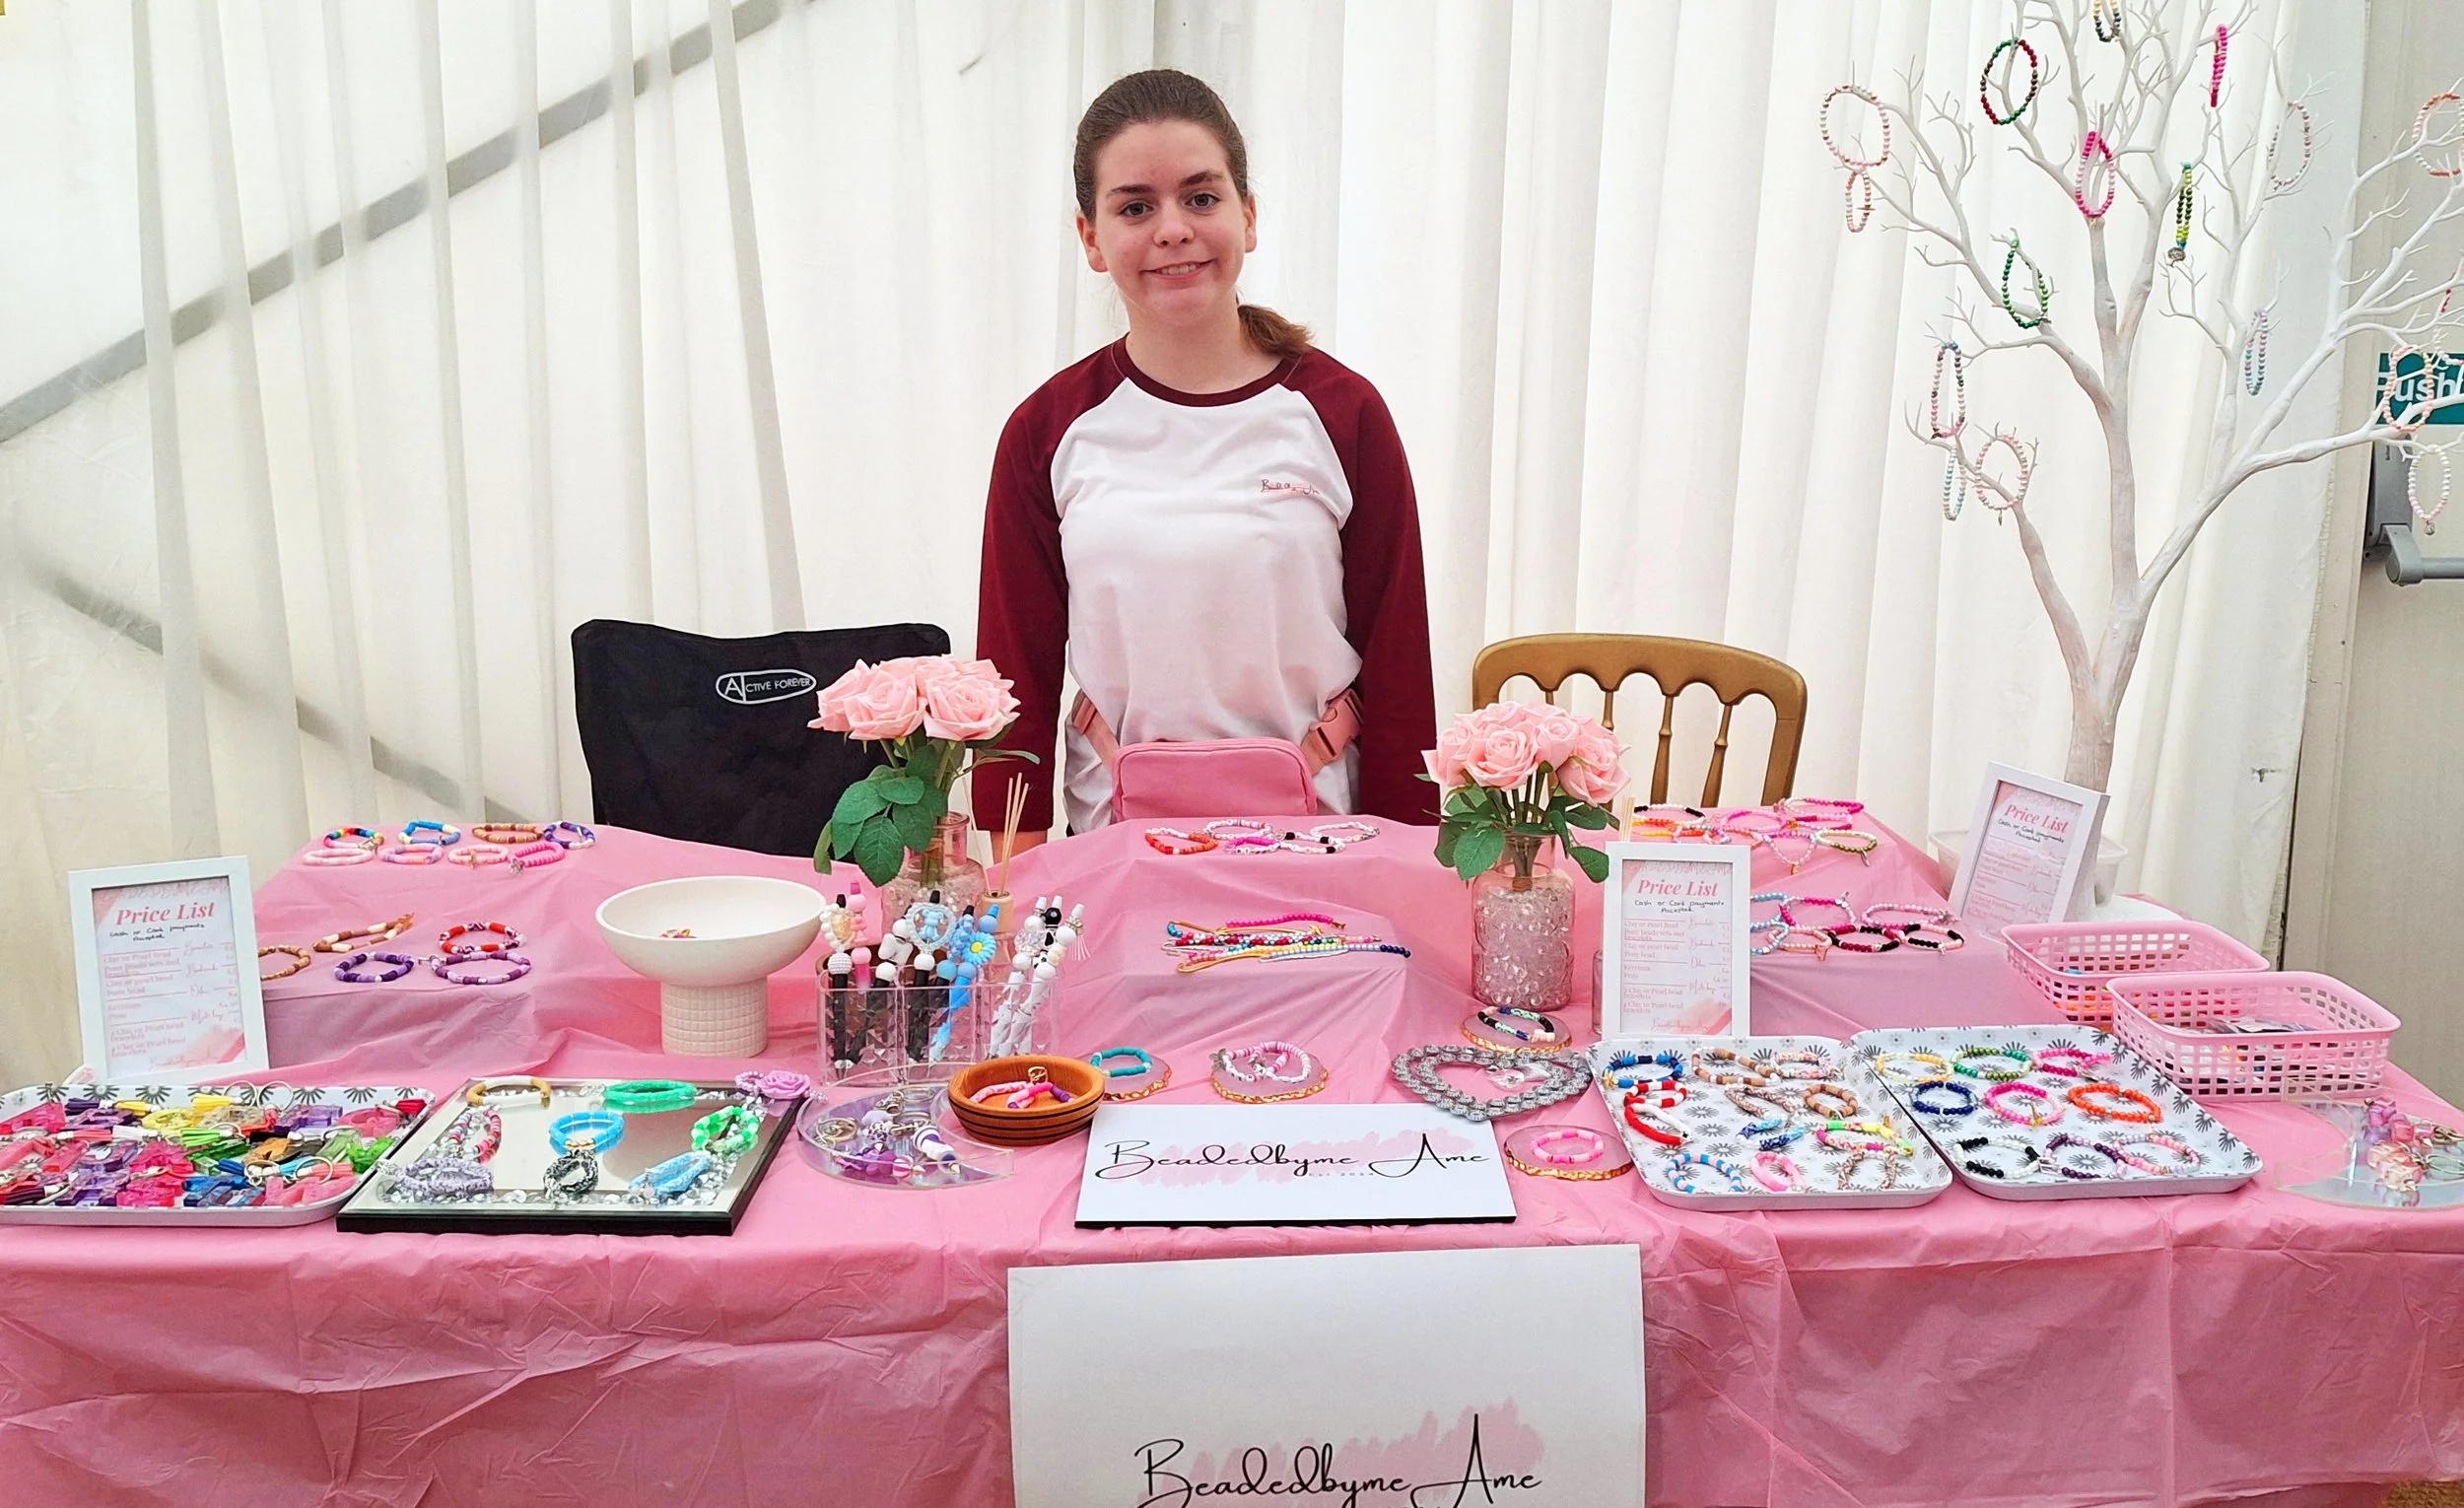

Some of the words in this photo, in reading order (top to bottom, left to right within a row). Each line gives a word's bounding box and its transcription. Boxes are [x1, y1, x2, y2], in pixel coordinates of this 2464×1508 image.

[724, 677, 772, 696] ACTIVE
[775, 677, 810, 689] FOREVER
[2004, 804, 2040, 824] Price
[2041, 815, 2069, 833] List
[1638, 879, 1681, 895] Price
[1686, 880, 1719, 897] List
[116, 906, 171, 925] Price
[176, 902, 215, 921] List
[1095, 1140, 1358, 1179] Beadedbyme
[1368, 1133, 1489, 1179] Ame
[1134, 1439, 1412, 1508] Beadedbyme
[1410, 1413, 1542, 1508] Ame
